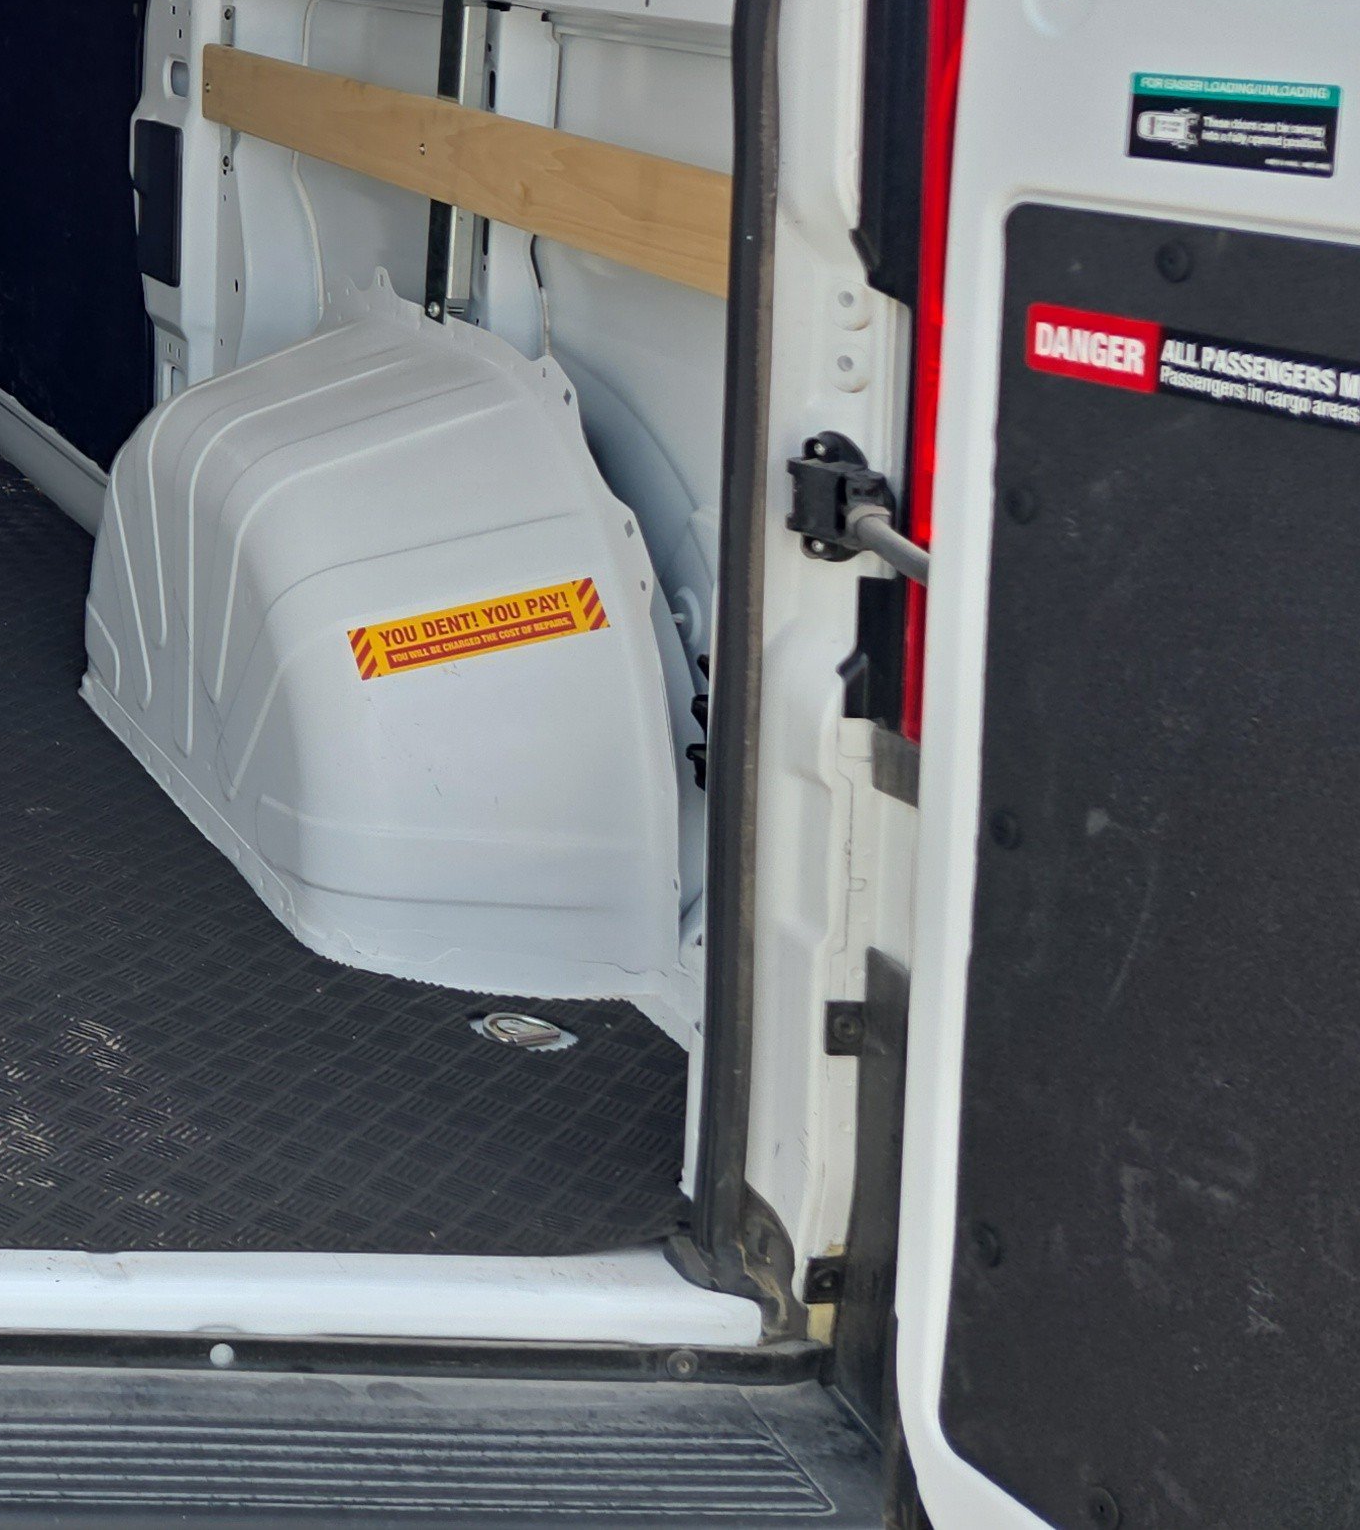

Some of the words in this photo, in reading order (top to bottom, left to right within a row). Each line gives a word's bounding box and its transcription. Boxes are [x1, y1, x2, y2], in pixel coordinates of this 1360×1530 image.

[1140, 77, 1165, 89] FOR
[1165, 78, 1203, 91] EASIER
[1034, 322, 1145, 375] DANGER
[1160, 339, 1200, 369] ALL
[1201, 346, 1337, 396] PASSENGERS
[1339, 372, 1360, 400] M
[1160, 365, 1247, 401] Passengers
[1247, 382, 1265, 404] in
[1265, 389, 1311, 416] cargo
[378, 625, 418, 648] YOU
[421, 611, 480, 639] DENT!
[481, 601, 521, 625] YOU
[525, 591, 570, 616] PAY!
[391, 652, 409, 664] YOU
[410, 647, 430, 660] WILL
[430, 644, 442, 656] BE
[442, 636, 481, 653] CHARGED
[480, 631, 498, 644] THE
[499, 626, 522, 641] COST
[522, 624, 535, 636] OF
[535, 616, 572, 632] REPAIRS.
